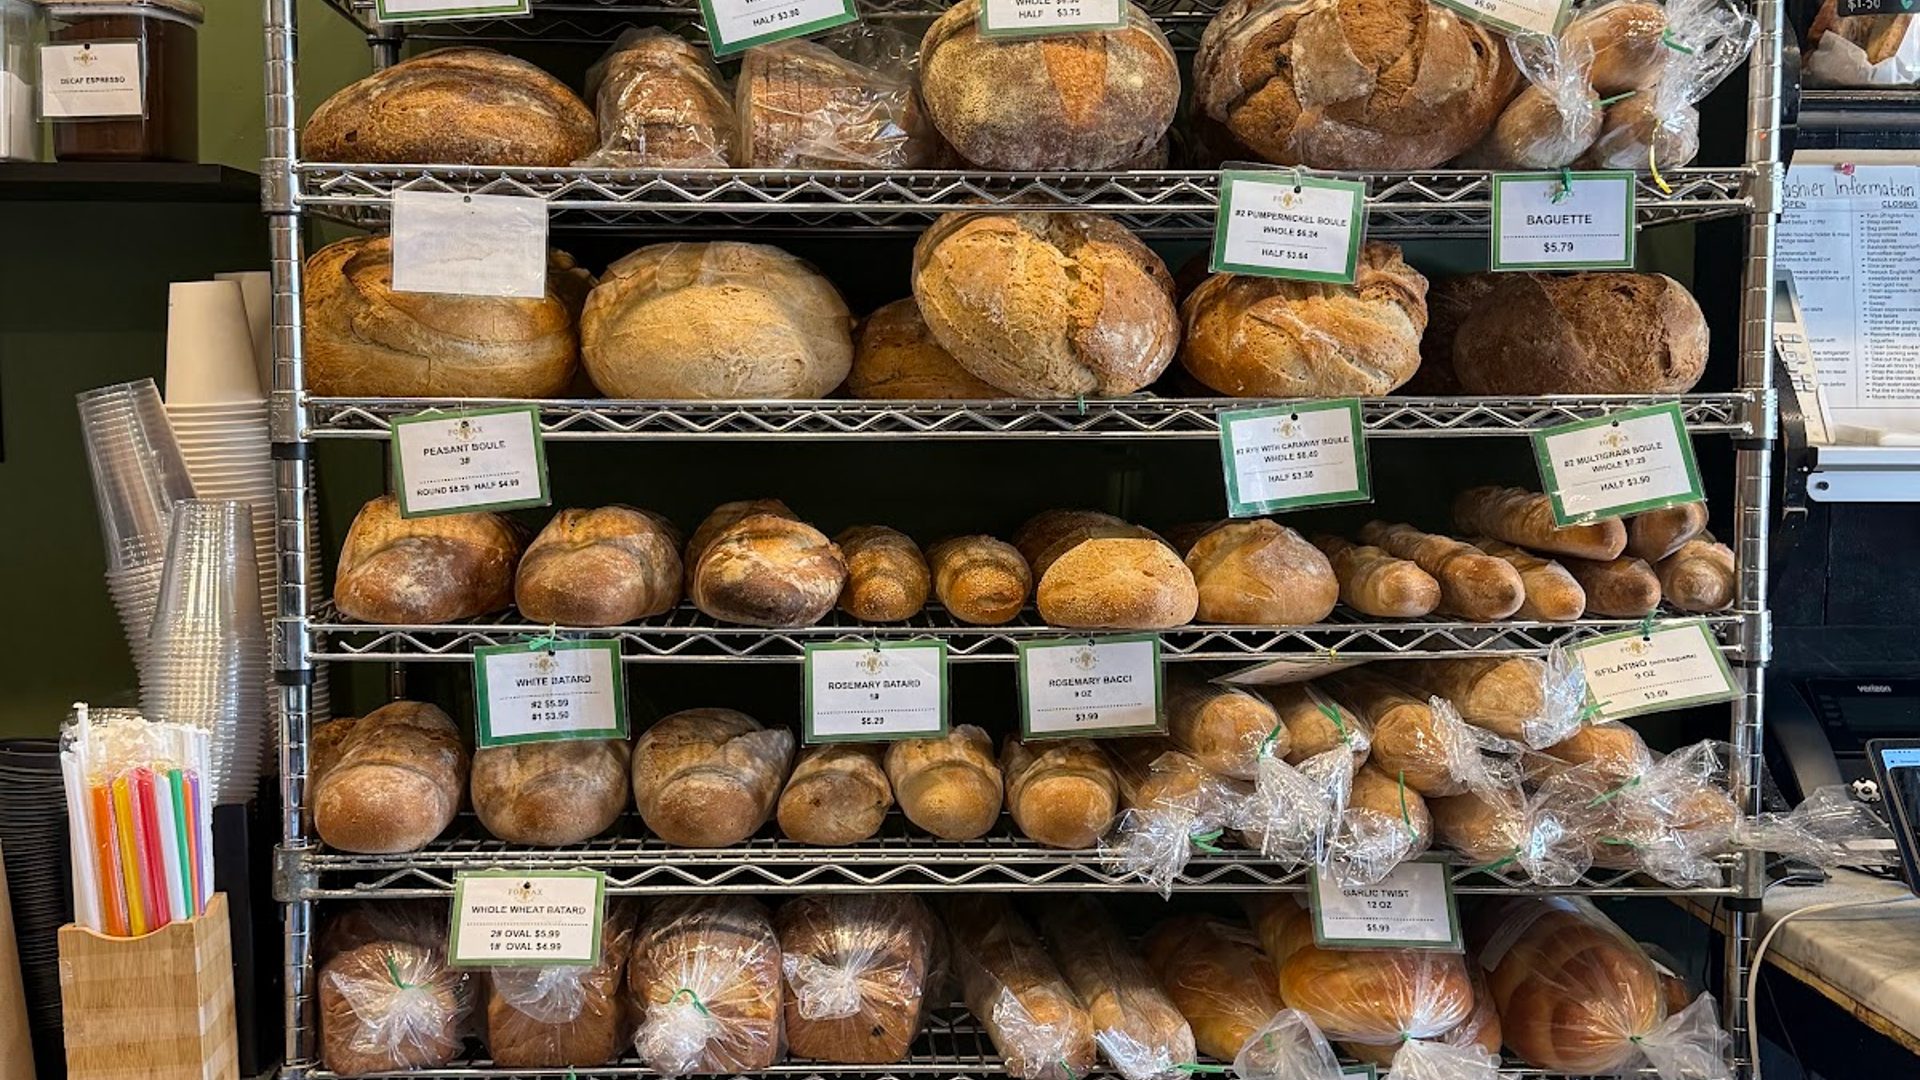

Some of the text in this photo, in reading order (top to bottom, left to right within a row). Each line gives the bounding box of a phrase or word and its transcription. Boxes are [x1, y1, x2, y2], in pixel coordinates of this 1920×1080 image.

[1018, 8, 1081, 19] HALF $3.75
[752, 12, 776, 27] HALF
[60, 76, 126, 85] DECAF ESPRESSO
[1783, 174, 1915, 198] ashier Information
[1881, 200, 1918, 209] CLOSING
[1247, 210, 1315, 224] PUMPERNICKEL
[1317, 216, 1347, 227] BOULE
[1526, 214, 1593, 226] BAGUETTE
[1263, 226, 1294, 237] WHOLE
[1261, 248, 1285, 258] HALF
[1543, 242, 1574, 253] $5.79
[423, 440, 507, 457] PEASANT BOULE
[1260, 444, 1281, 453] WITH
[1281, 440, 1320, 450] CARAWAY
[1321, 436, 1350, 446] BOULE
[1263, 453, 1295, 463] WHOLE
[1576, 447, 1632, 465] MULTIGRAIN
[1633, 441, 1663, 455] BOULE
[1591, 461, 1624, 473] WHOLE
[1268, 473, 1290, 483] HALF
[416, 485, 448, 497] ROUND
[474, 481, 497, 491] HALF
[498, 478, 520, 489] $4.99
[1600, 481, 1625, 492] HALF
[1594, 659, 1648, 678] SFILATINO
[1642, 669, 1657, 678] OZ
[515, 674, 592, 688] WHITE BATARD
[827, 679, 921, 690] ROSEMARY BATARD
[1048, 674, 1133, 688] ROSEMARY BACCI
[1081, 690, 1093, 698] OZ
[1857, 684, 1893, 693] verizon
[1343, 889, 1410, 898] GARLIC TWIST
[471, 905, 587, 915] WHOLE WHEAT BATARD
[1366, 901, 1393, 909] 12 OZ
[490, 929, 561, 939] 2# OVAL $5.99
[505, 942, 533, 951] OVAL
[536, 942, 562, 952] $4.99
